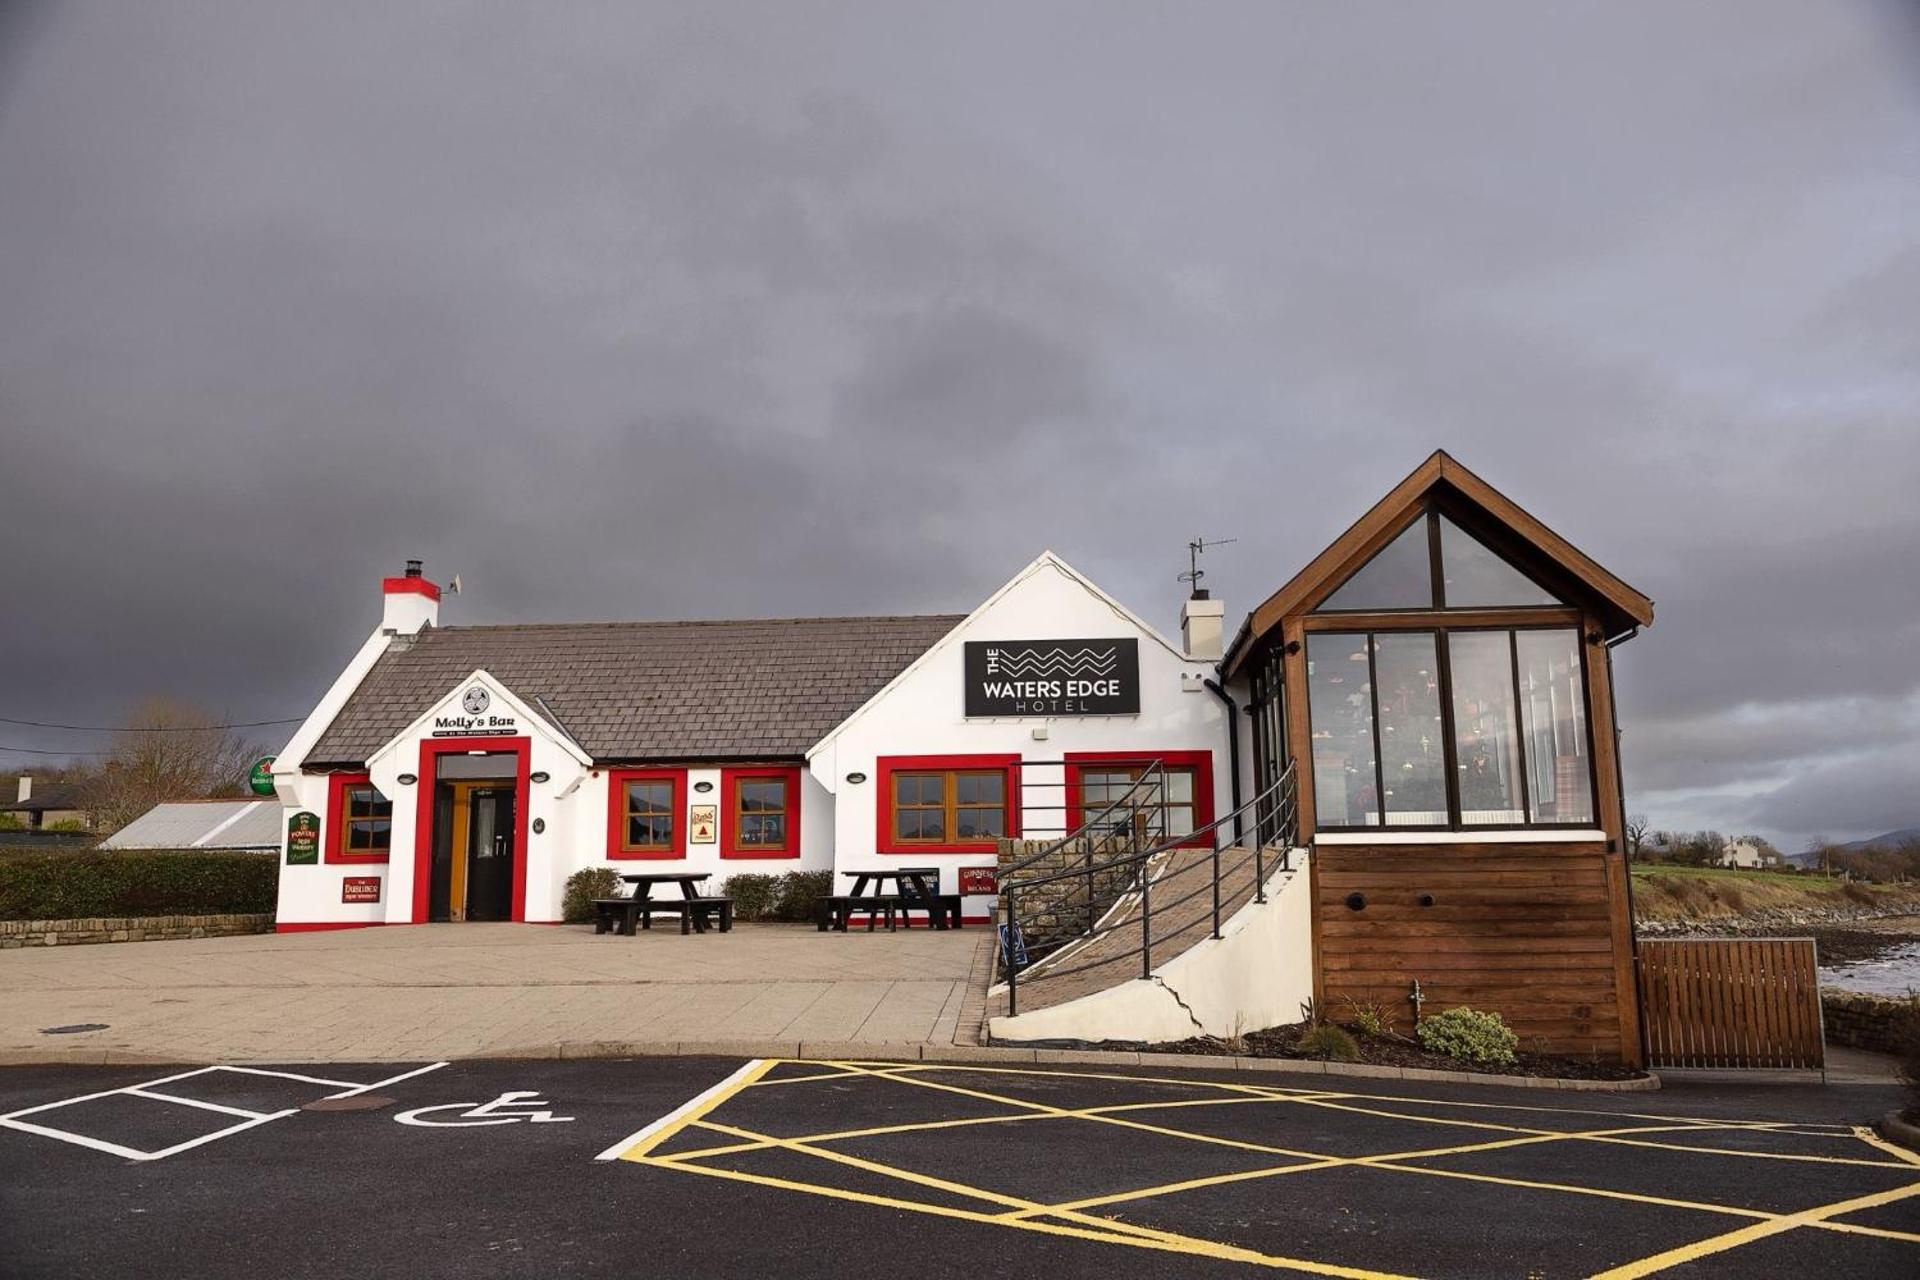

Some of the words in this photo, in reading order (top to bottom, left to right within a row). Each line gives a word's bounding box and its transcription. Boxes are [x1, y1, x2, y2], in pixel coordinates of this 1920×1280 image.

[987, 648, 999, 675] THE
[983, 680, 1061, 698] WATERS
[1066, 680, 1120, 696] EDGE
[1015, 700, 1089, 712] HOTEL
[435, 717, 485, 730] Molly's
